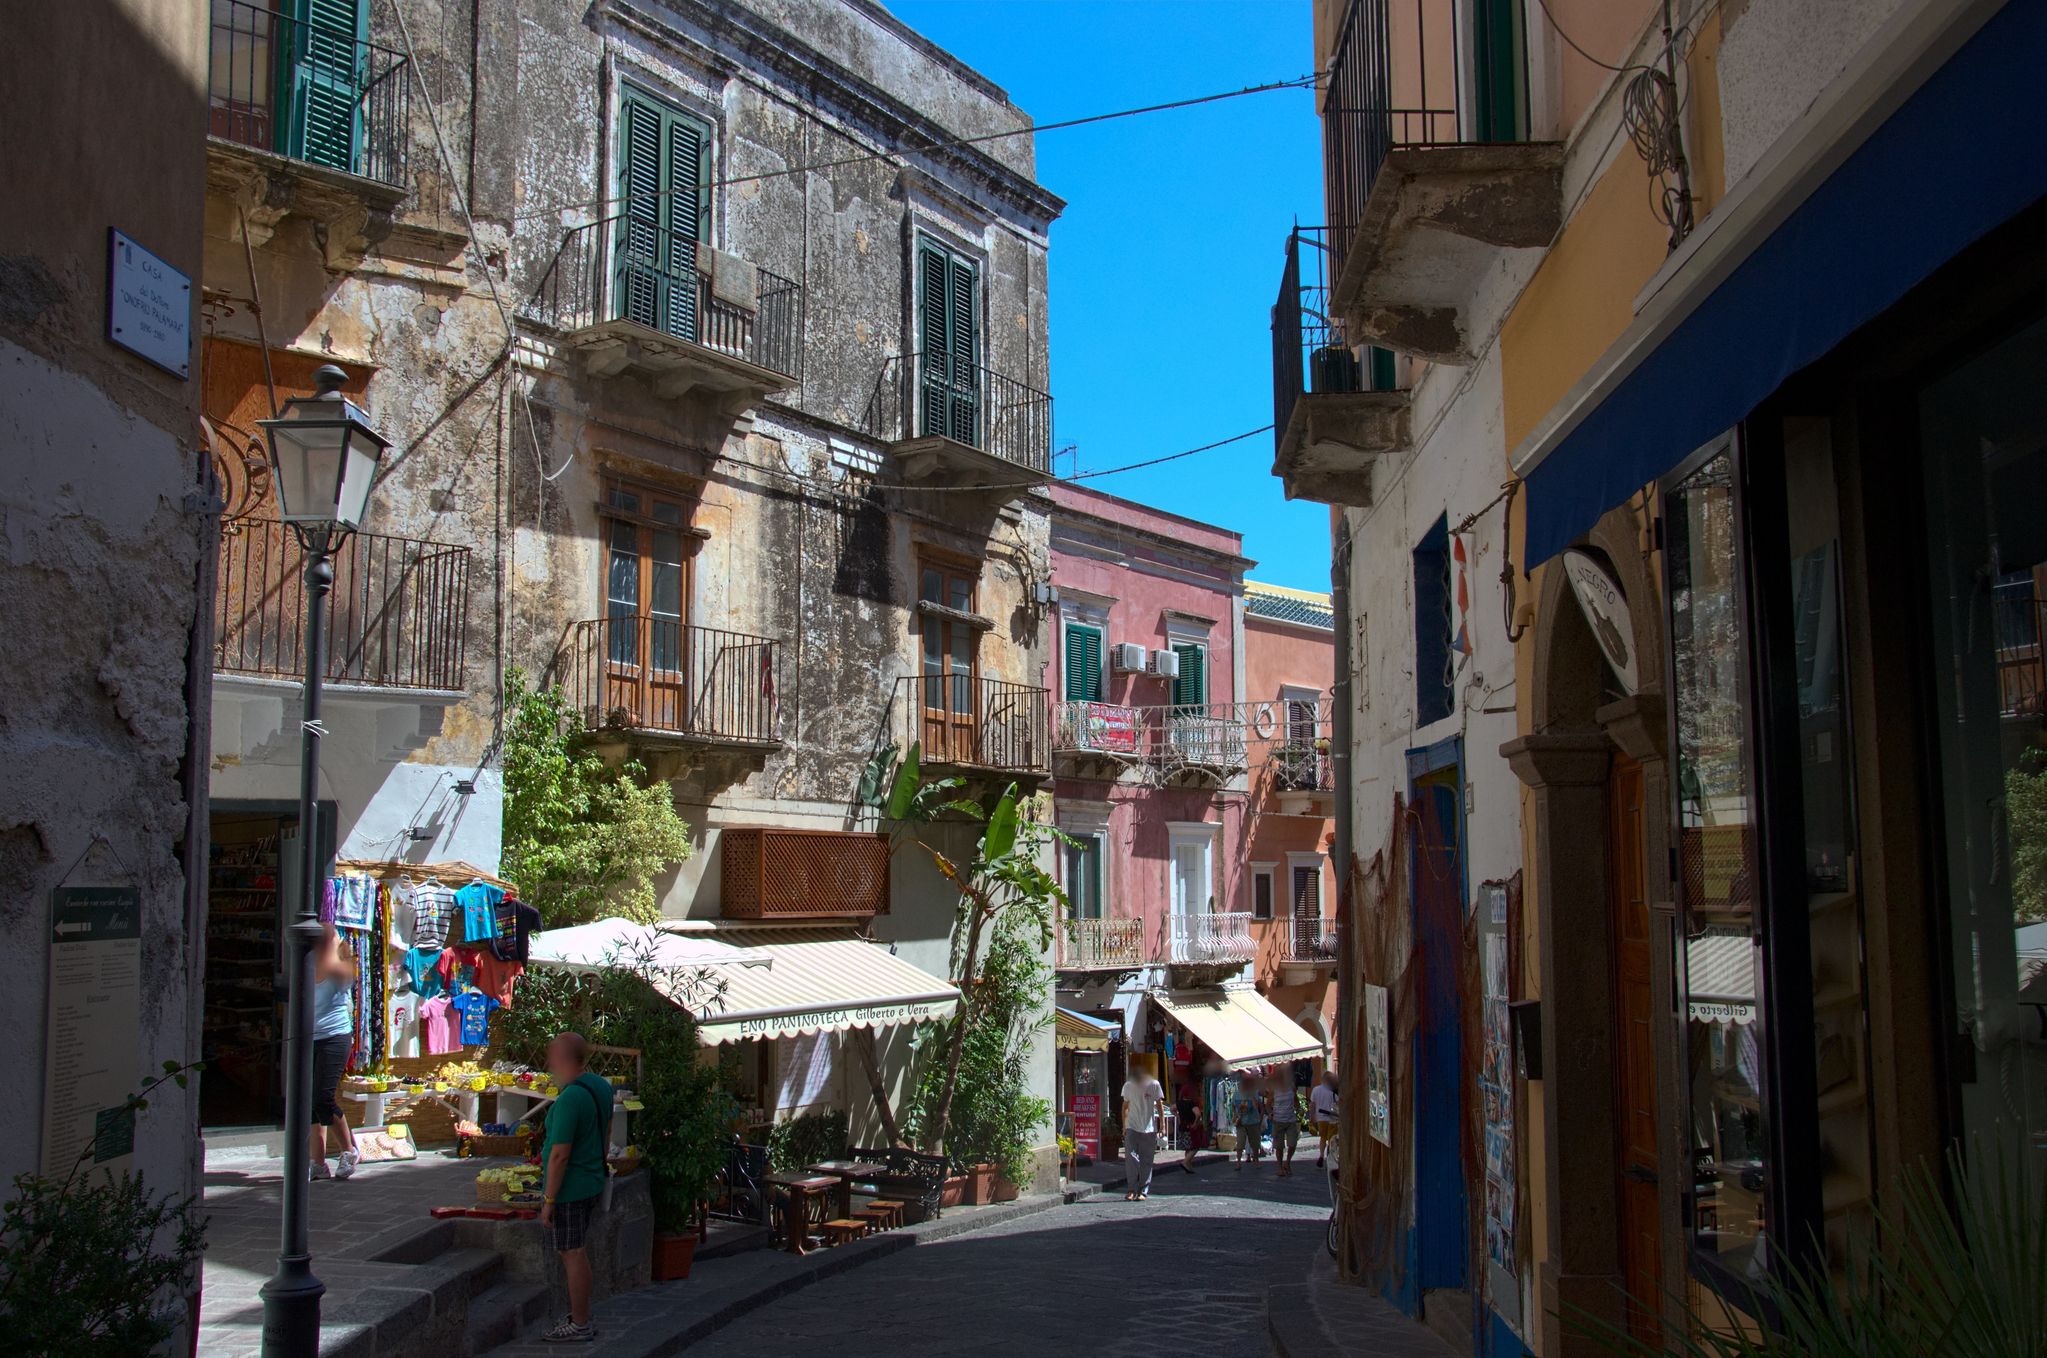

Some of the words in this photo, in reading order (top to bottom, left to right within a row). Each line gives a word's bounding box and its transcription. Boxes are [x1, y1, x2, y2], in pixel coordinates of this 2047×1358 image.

[142, 261, 162, 281] CASA
[740, 1019, 767, 1034] ENO
[772, 1009, 849, 1030] PANINOTECA
[855, 1007, 895, 1021] Gilberto
[898, 1008, 904, 1016] e
[907, 1004, 929, 1015] Vera
